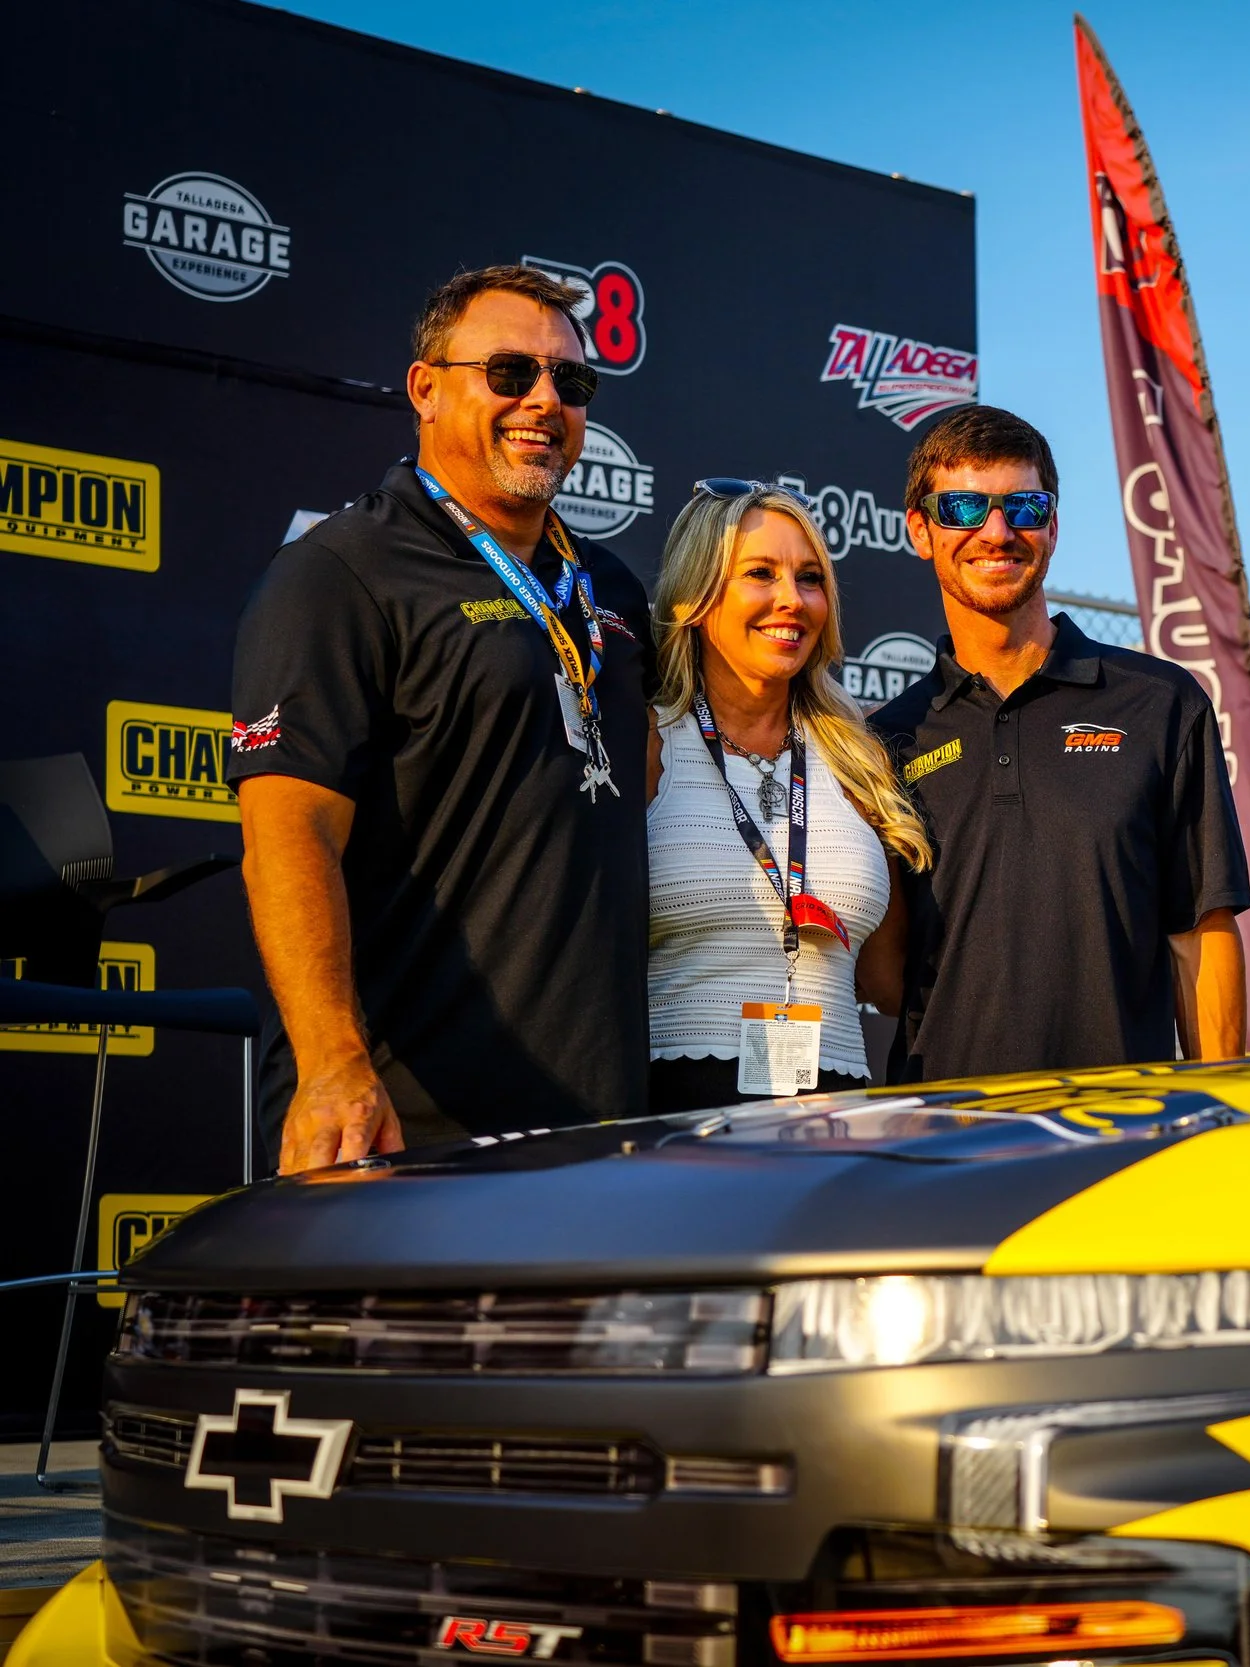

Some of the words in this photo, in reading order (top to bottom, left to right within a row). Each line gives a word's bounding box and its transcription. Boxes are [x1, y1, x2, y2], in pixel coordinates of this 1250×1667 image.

[175, 190, 246, 215] TALLADEGA
[123, 202, 290, 269] GARAGE
[172, 258, 248, 283] EXPERIENCE
[826, 328, 978, 400] TALLADEGA
[445, 502, 471, 524] NASCAR
[481, 540, 521, 586] OUTDOORS
[462, 599, 524, 617] CHAMPION
[563, 646, 580, 678] TRUCK
[1064, 745, 1120, 753] RACING
[1065, 733, 1123, 746] GMS
[905, 740, 961, 779] CHAMPION
[131, 783, 213, 798] POWER
[791, 785, 805, 828] NASCAR
[434, 1616, 583, 1659] RST
